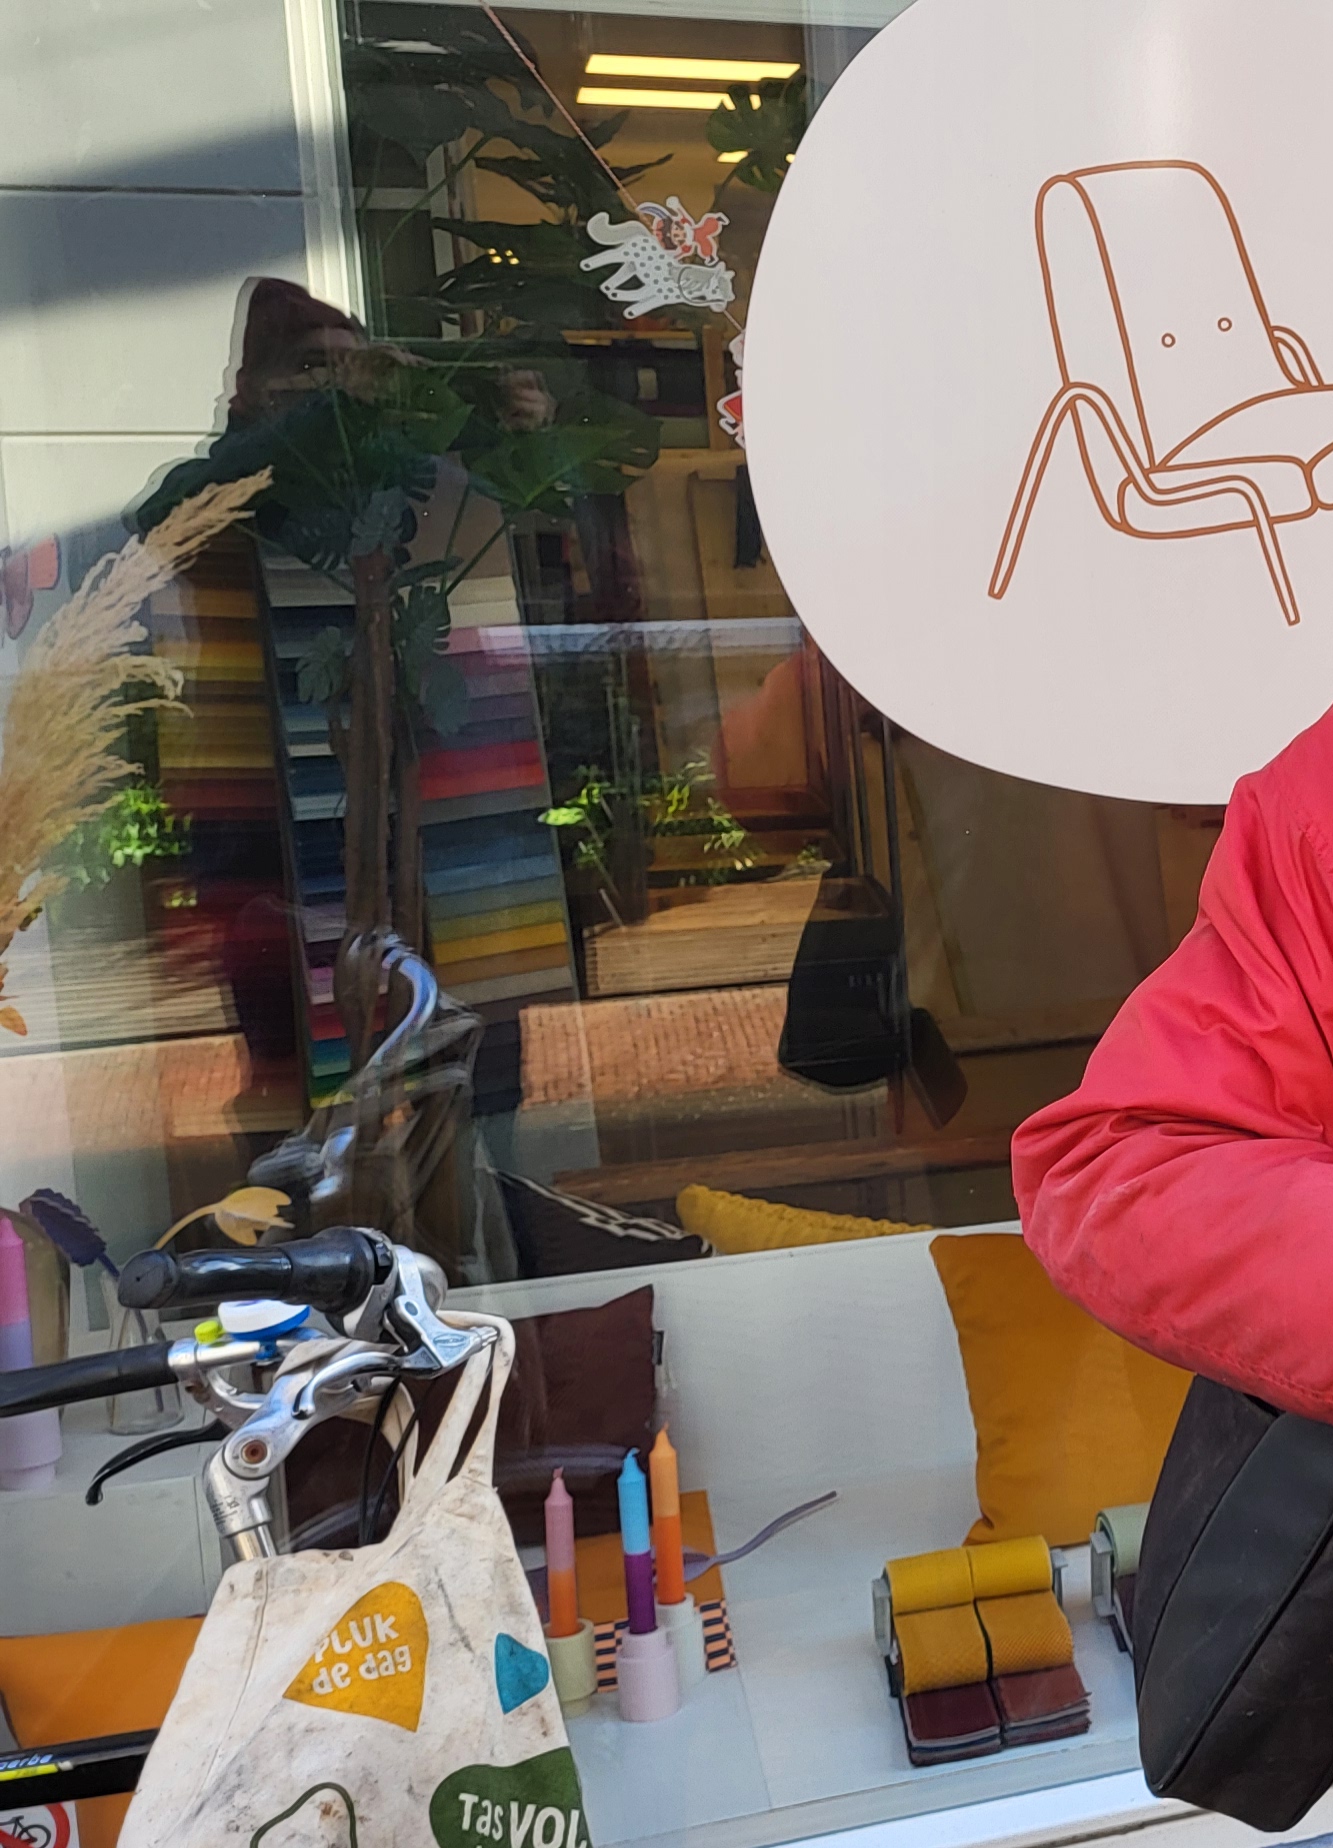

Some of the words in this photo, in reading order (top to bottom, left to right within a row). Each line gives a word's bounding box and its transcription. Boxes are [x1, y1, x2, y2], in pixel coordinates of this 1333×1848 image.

[313, 1612, 399, 1663] PLUK
[312, 1662, 352, 1696] de
[359, 1644, 412, 1681] dag
